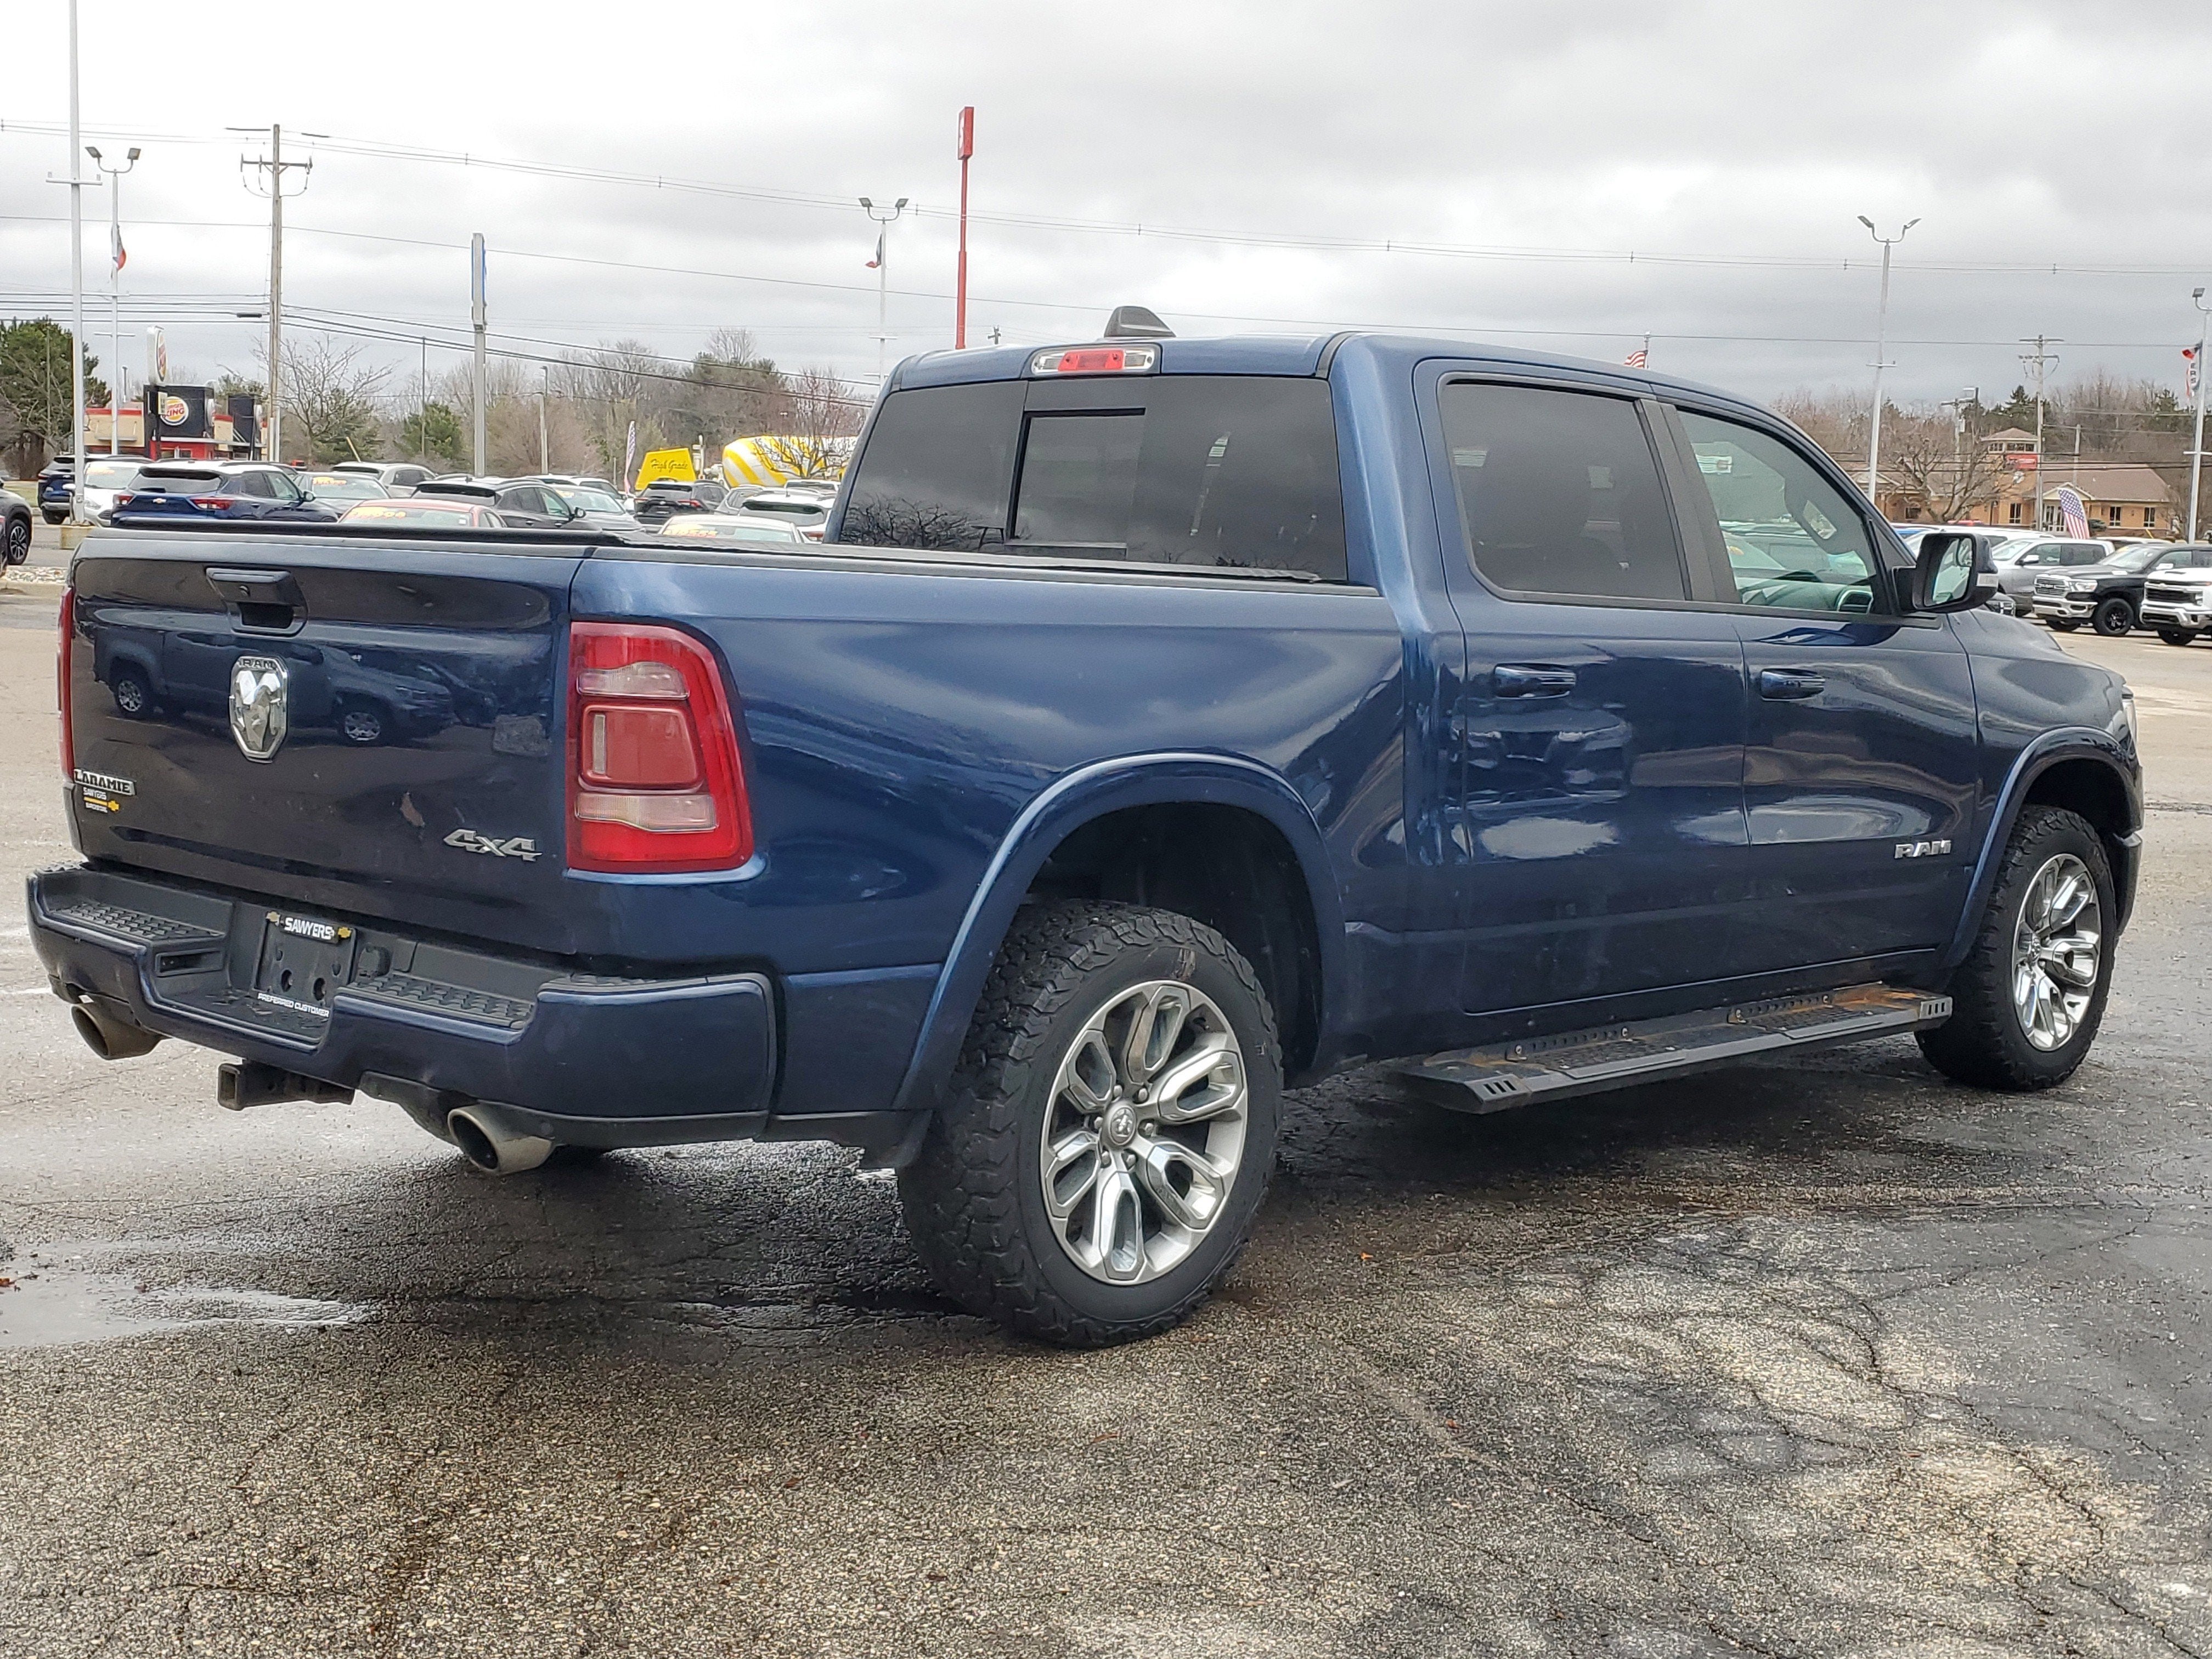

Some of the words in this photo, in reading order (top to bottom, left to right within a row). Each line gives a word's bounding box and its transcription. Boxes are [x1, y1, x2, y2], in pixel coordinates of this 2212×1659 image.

[651, 458, 668, 472] High
[242, 658, 275, 669] RAM
[74, 769, 131, 794] LARAMIE
[1894, 840, 1951, 859] RAM
[284, 917, 332, 940] SAWYERS
[258, 992, 295, 1008] PREFERRED
[294, 1002, 330, 1018] CUSTOMER
